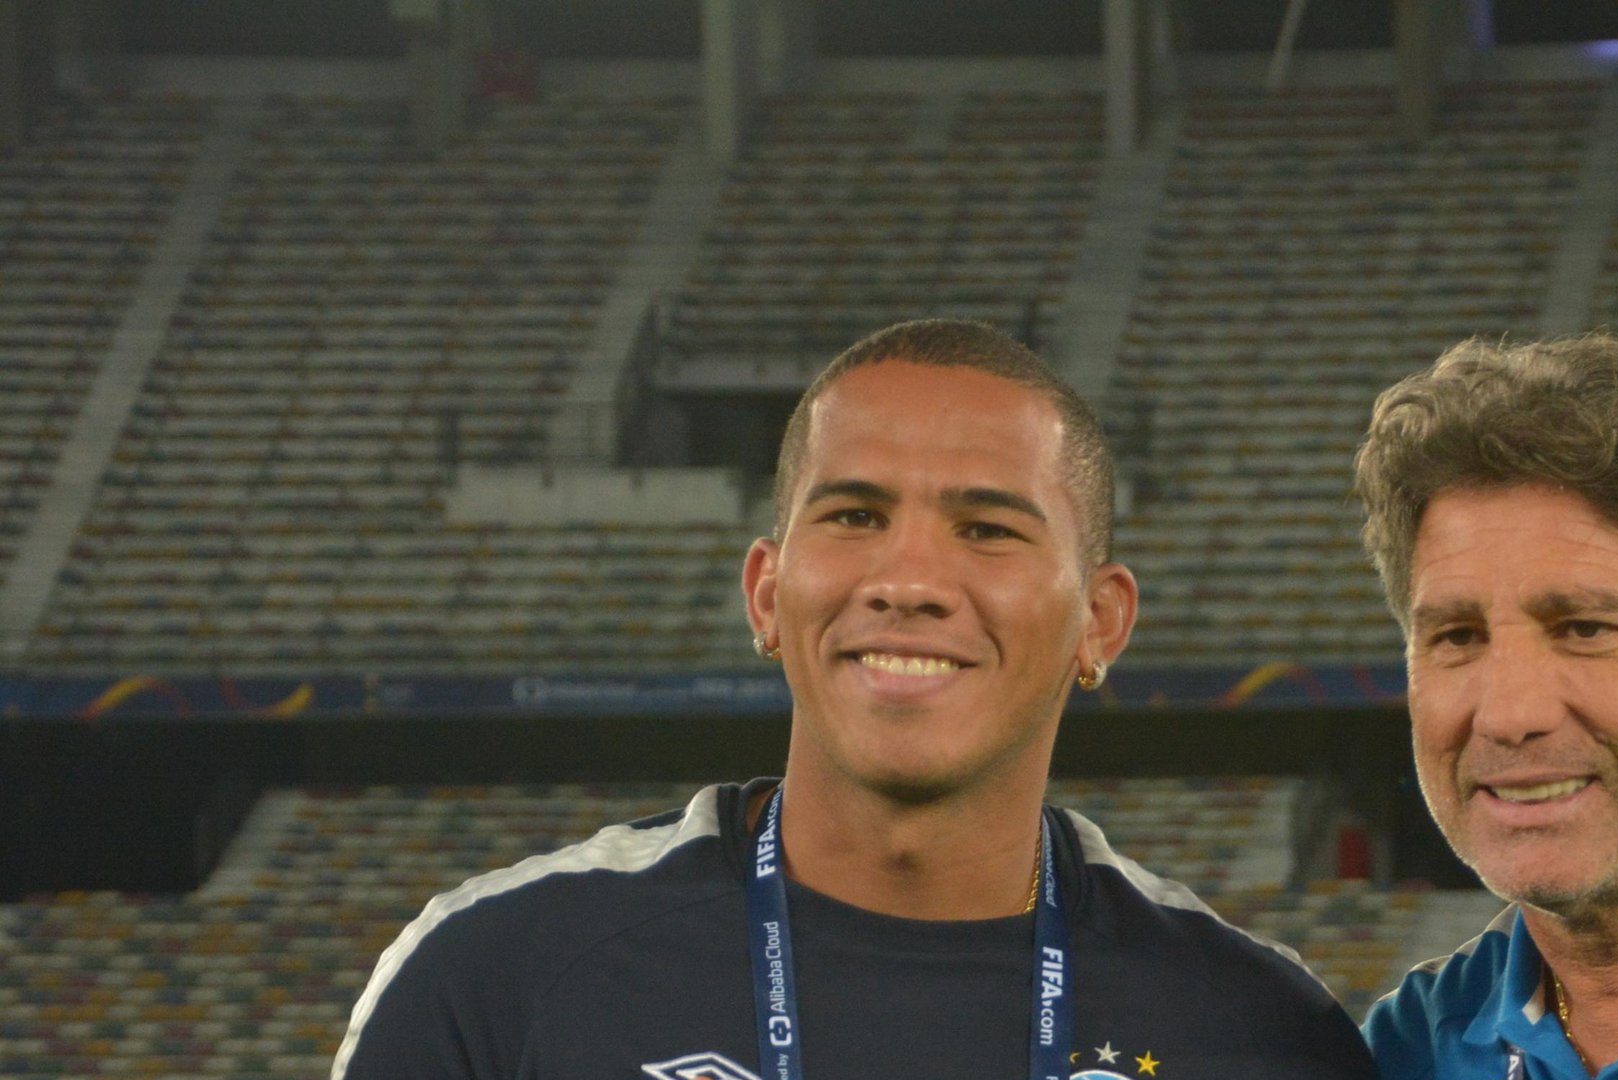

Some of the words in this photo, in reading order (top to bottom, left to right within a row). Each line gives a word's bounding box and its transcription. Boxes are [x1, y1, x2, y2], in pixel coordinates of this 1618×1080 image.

[763, 921, 780, 959] Cloud
[769, 961, 787, 1014] Alibaba
[777, 1053, 790, 1067] by
